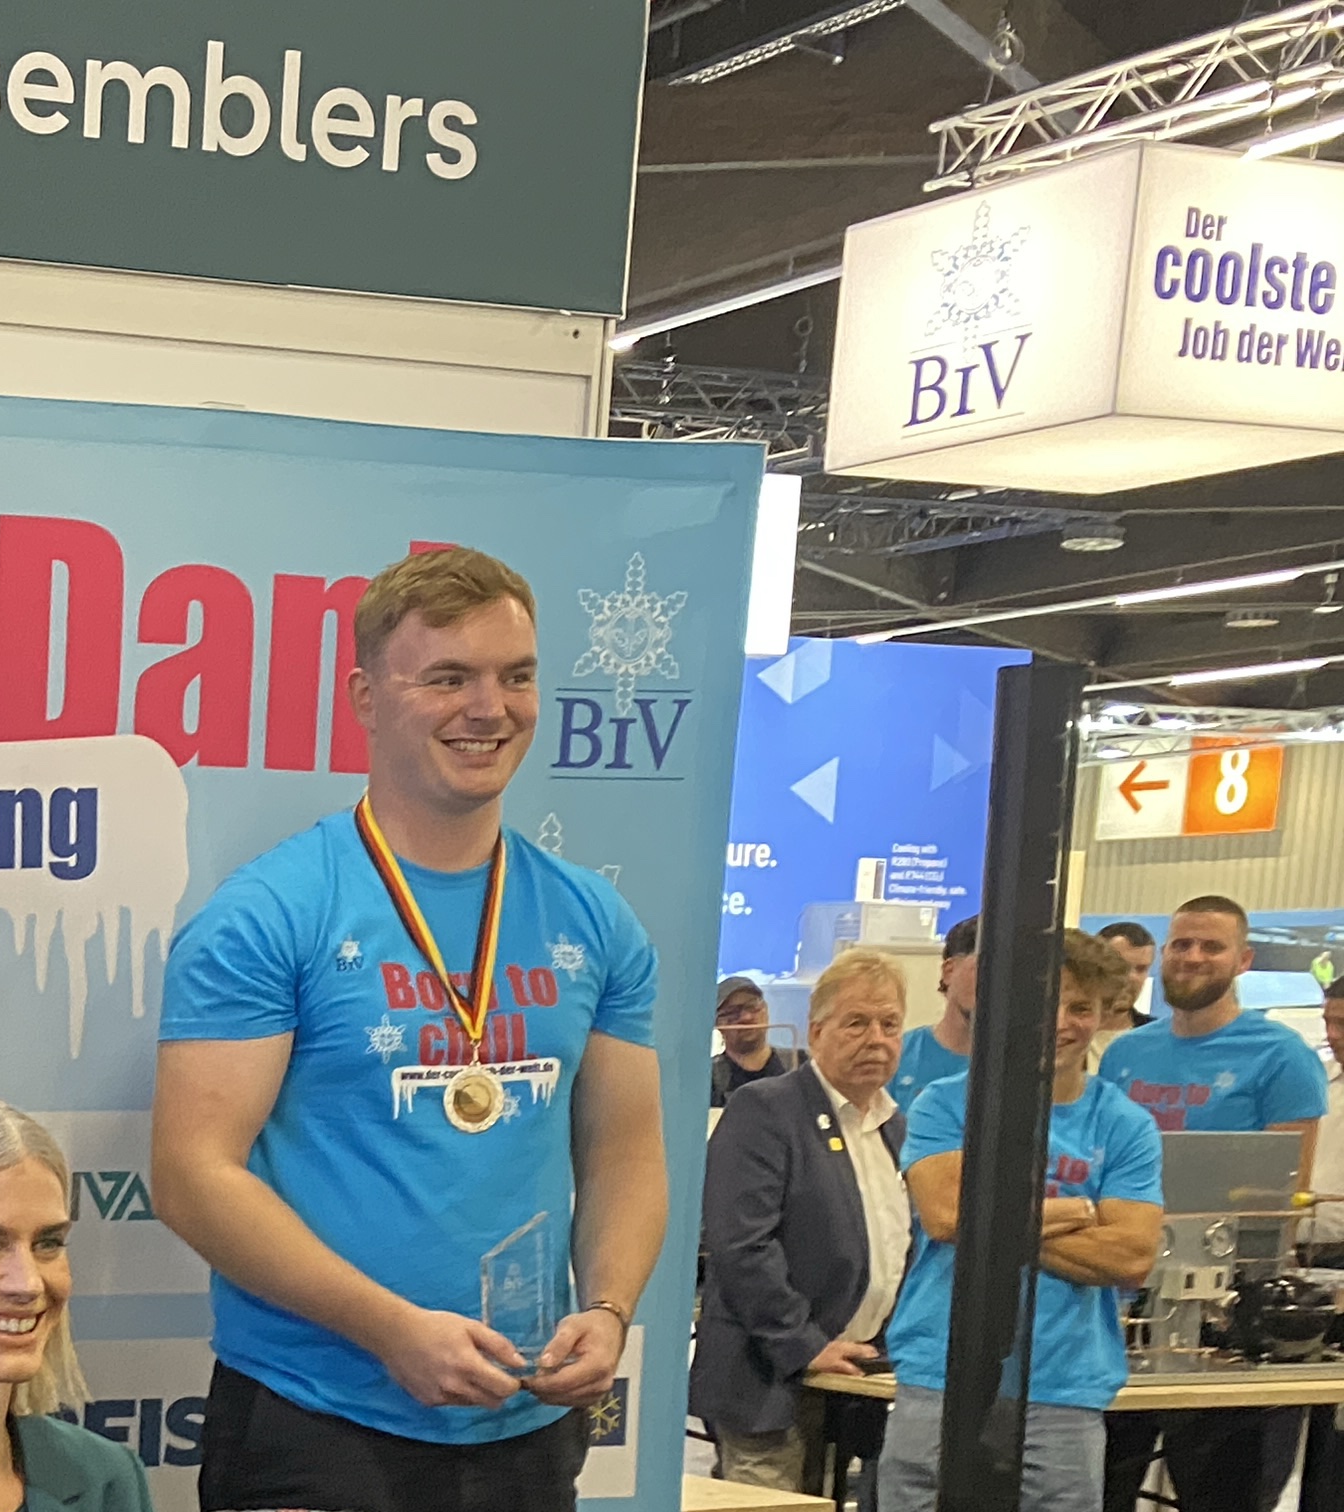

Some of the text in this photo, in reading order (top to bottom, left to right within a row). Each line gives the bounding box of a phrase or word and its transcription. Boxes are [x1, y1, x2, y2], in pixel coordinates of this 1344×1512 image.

[1185, 206, 1228, 241] Der
[1153, 242, 1338, 316] coolste
[1178, 317, 1344, 373] Job der We
[1215, 745, 1250, 815] 8
[727, 841, 778, 869] ure.
[505, 963, 559, 1009] to
